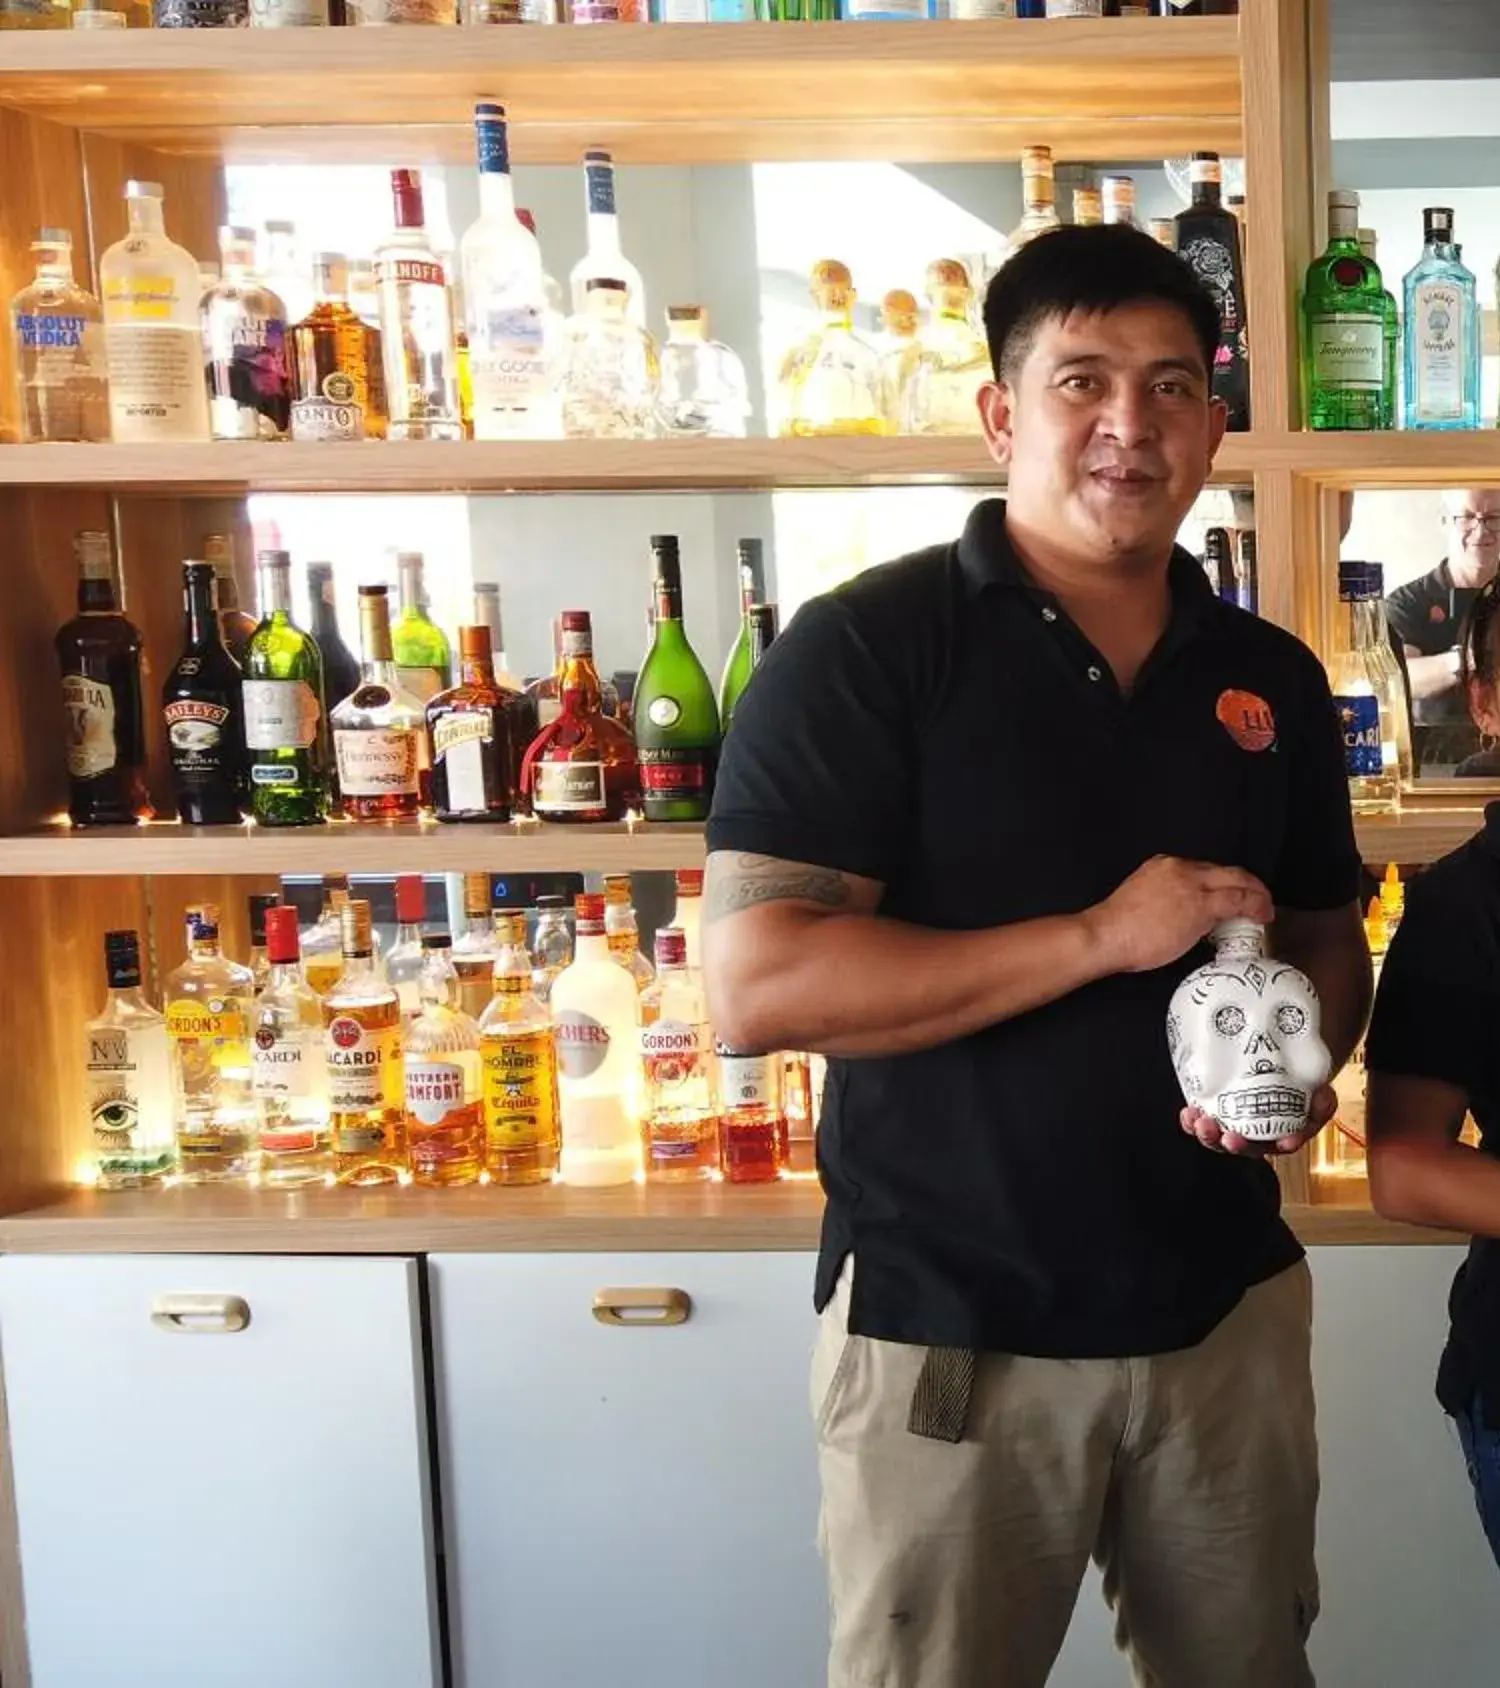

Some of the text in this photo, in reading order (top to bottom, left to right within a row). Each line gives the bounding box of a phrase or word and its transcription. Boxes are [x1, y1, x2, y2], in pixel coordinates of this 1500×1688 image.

[165, 702, 224, 720] BAILEYS
[168, 1015, 222, 1034] ORDON'S
[556, 1023, 611, 1044] CHERS
[254, 1050, 302, 1063] CARDI
[326, 1046, 382, 1066] ACARDI
[404, 1084, 460, 1101] OMFORT
